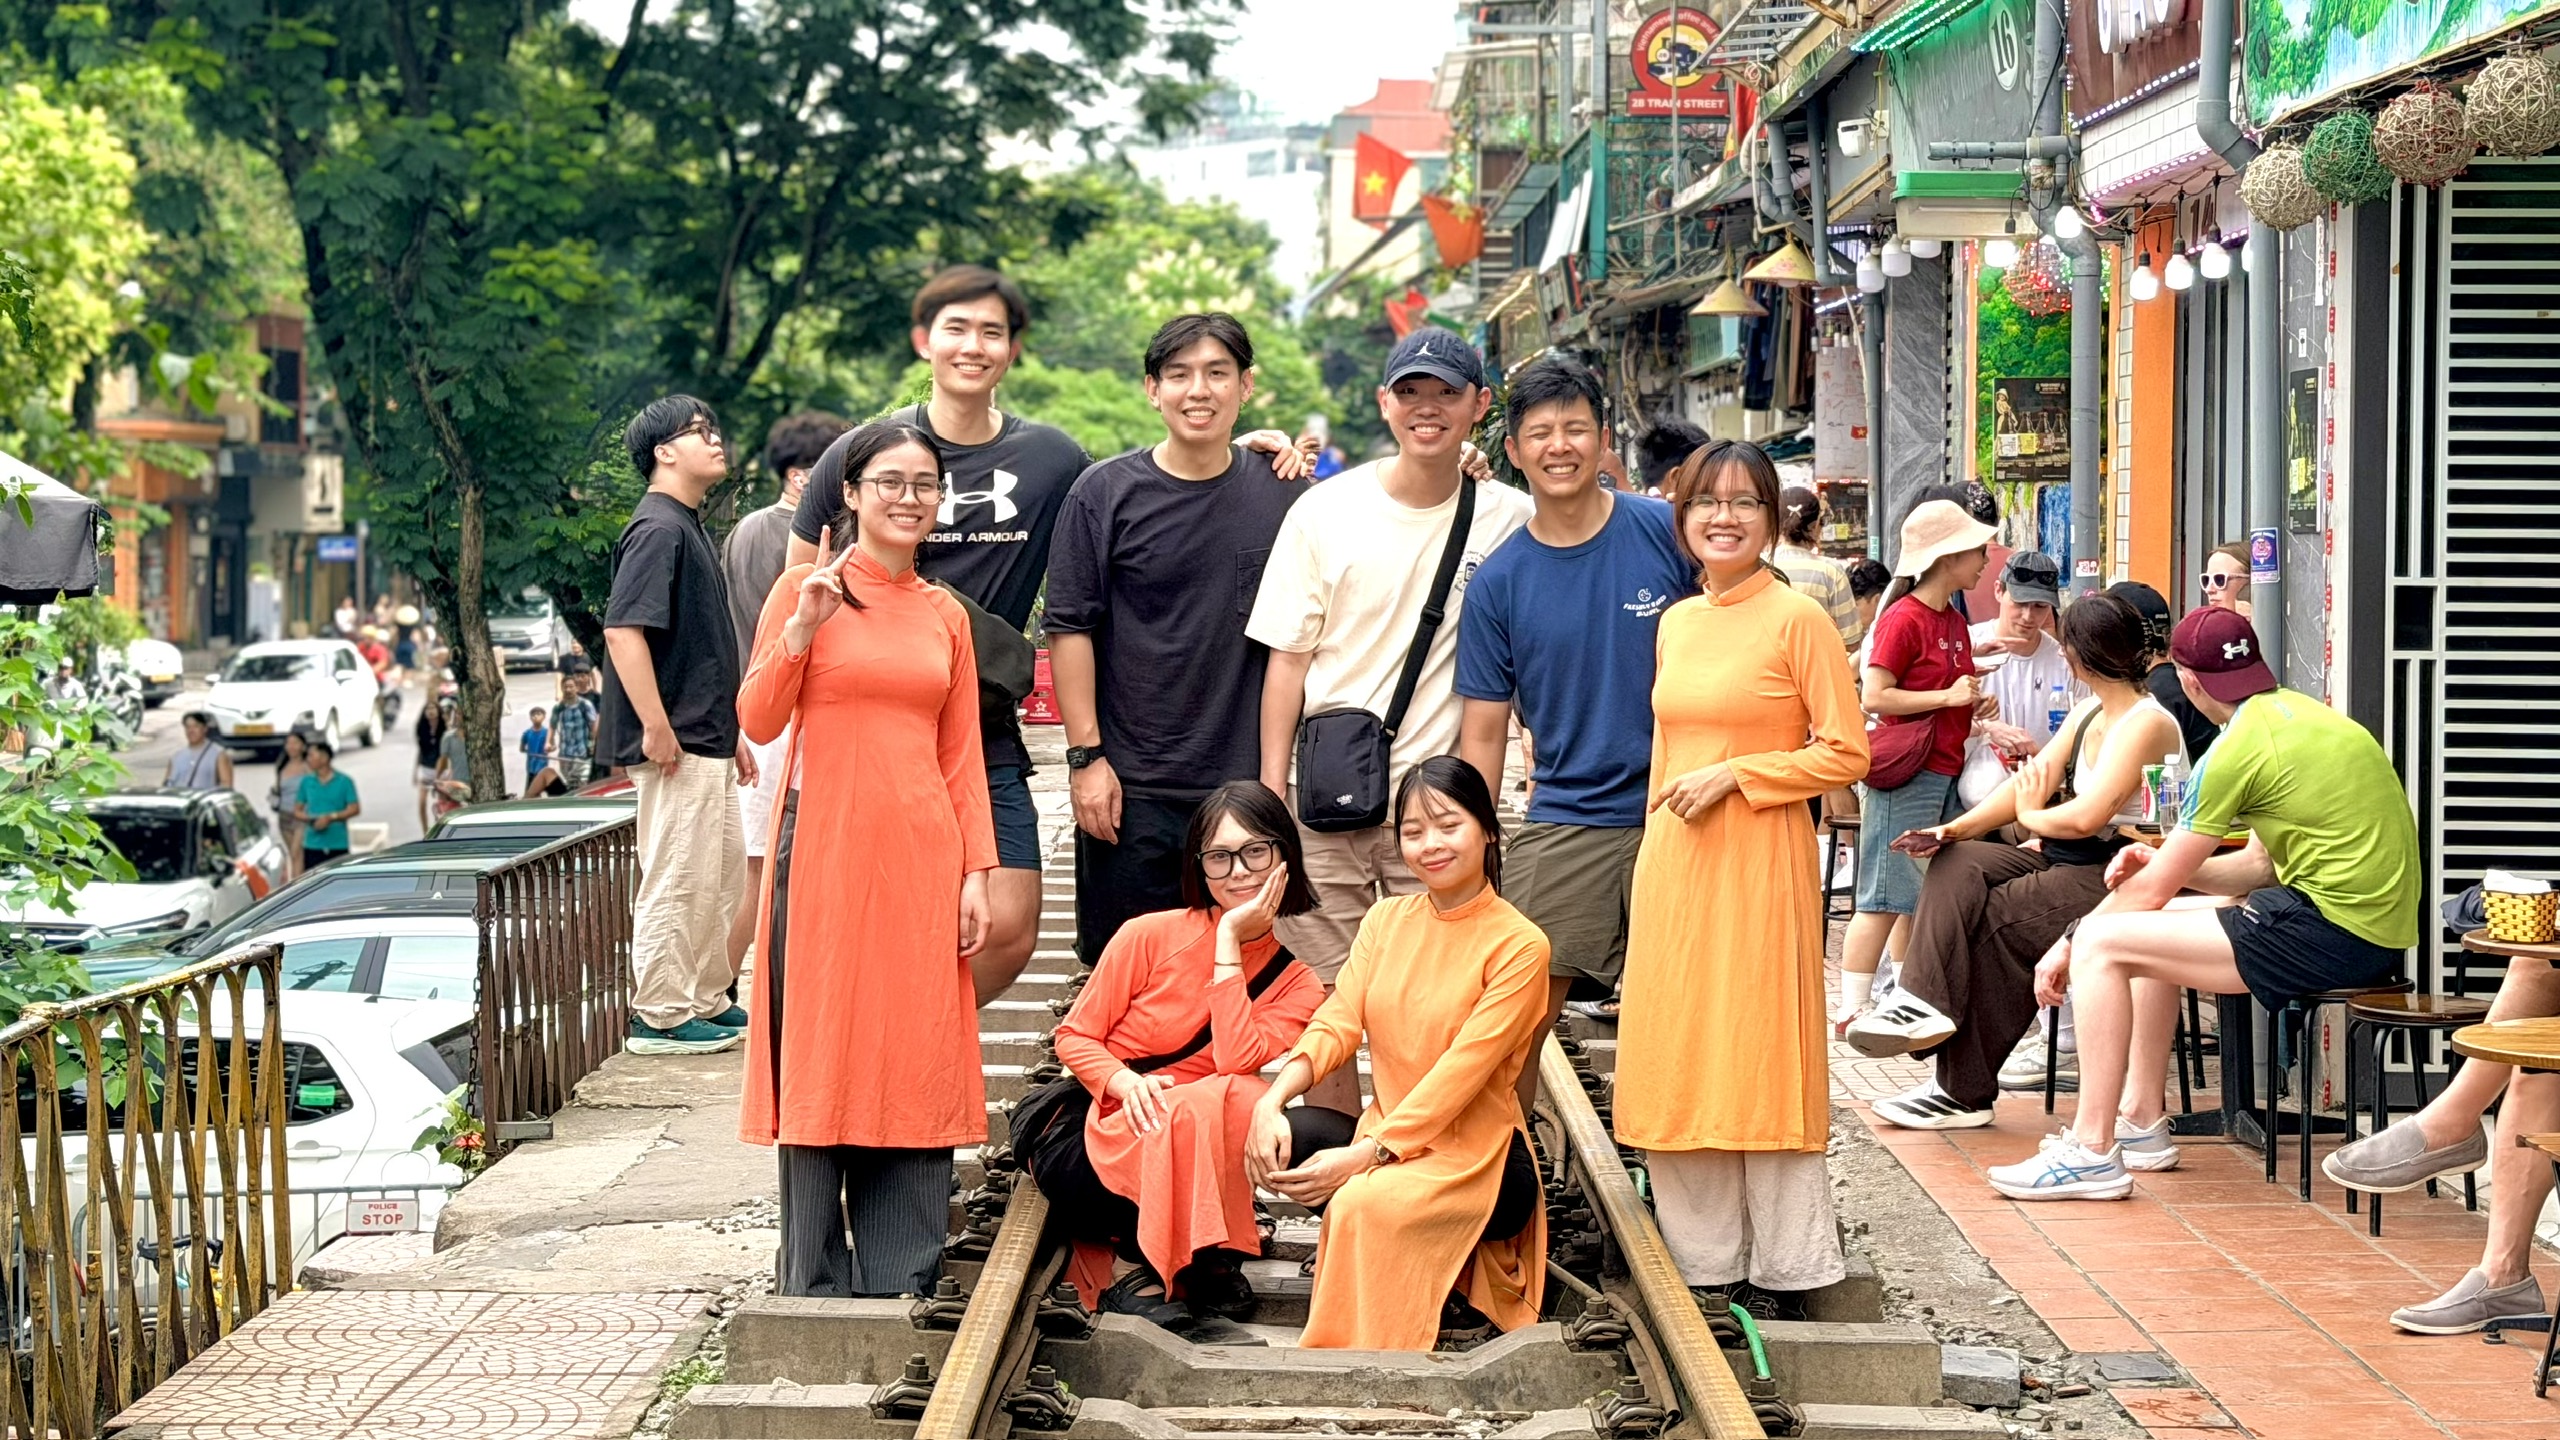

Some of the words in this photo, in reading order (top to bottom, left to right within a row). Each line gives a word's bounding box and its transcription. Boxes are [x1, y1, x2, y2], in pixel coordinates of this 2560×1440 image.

[1991, 10, 2015, 75] 16
[1683, 98, 1725, 109] STREET
[2190, 193, 2214, 247] 14
[921, 532, 963, 543] NDER
[966, 530, 1029, 543] ARMOUR
[362, 1214, 404, 1226] STOP
